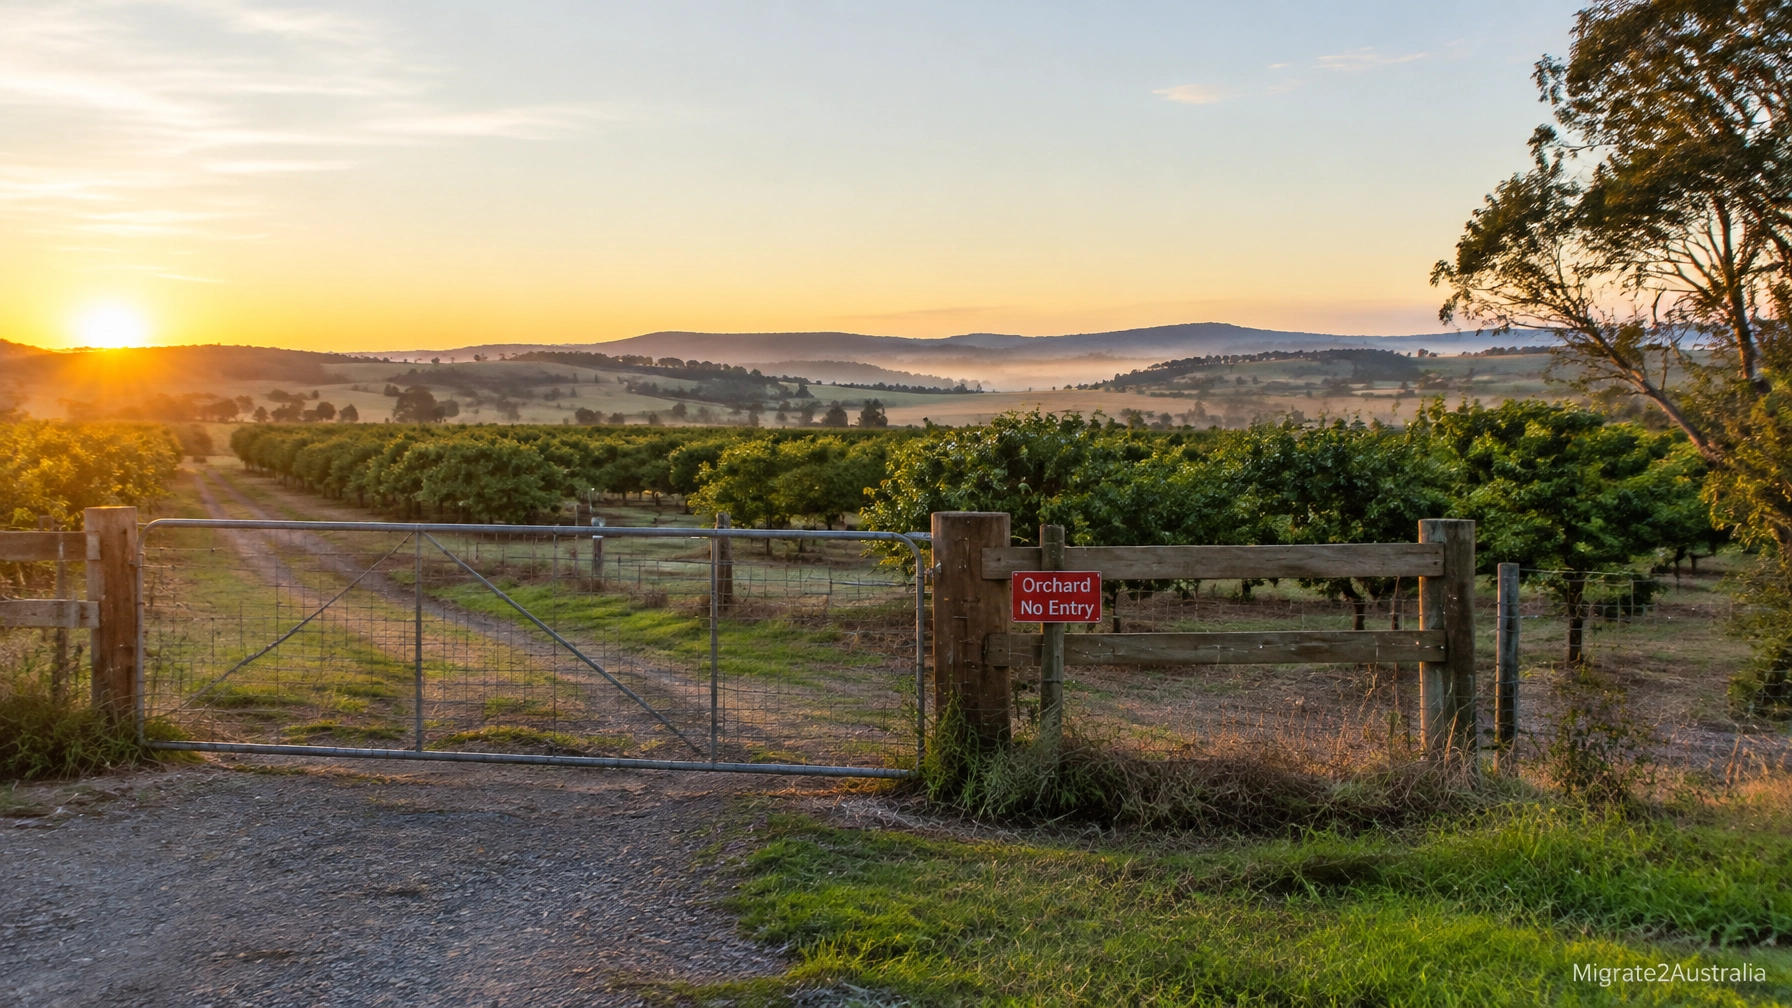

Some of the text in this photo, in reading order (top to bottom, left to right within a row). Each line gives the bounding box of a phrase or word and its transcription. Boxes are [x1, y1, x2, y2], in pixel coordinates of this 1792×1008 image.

[1023, 577, 1091, 593] Orchard
[1021, 600, 1094, 619] No Entry
